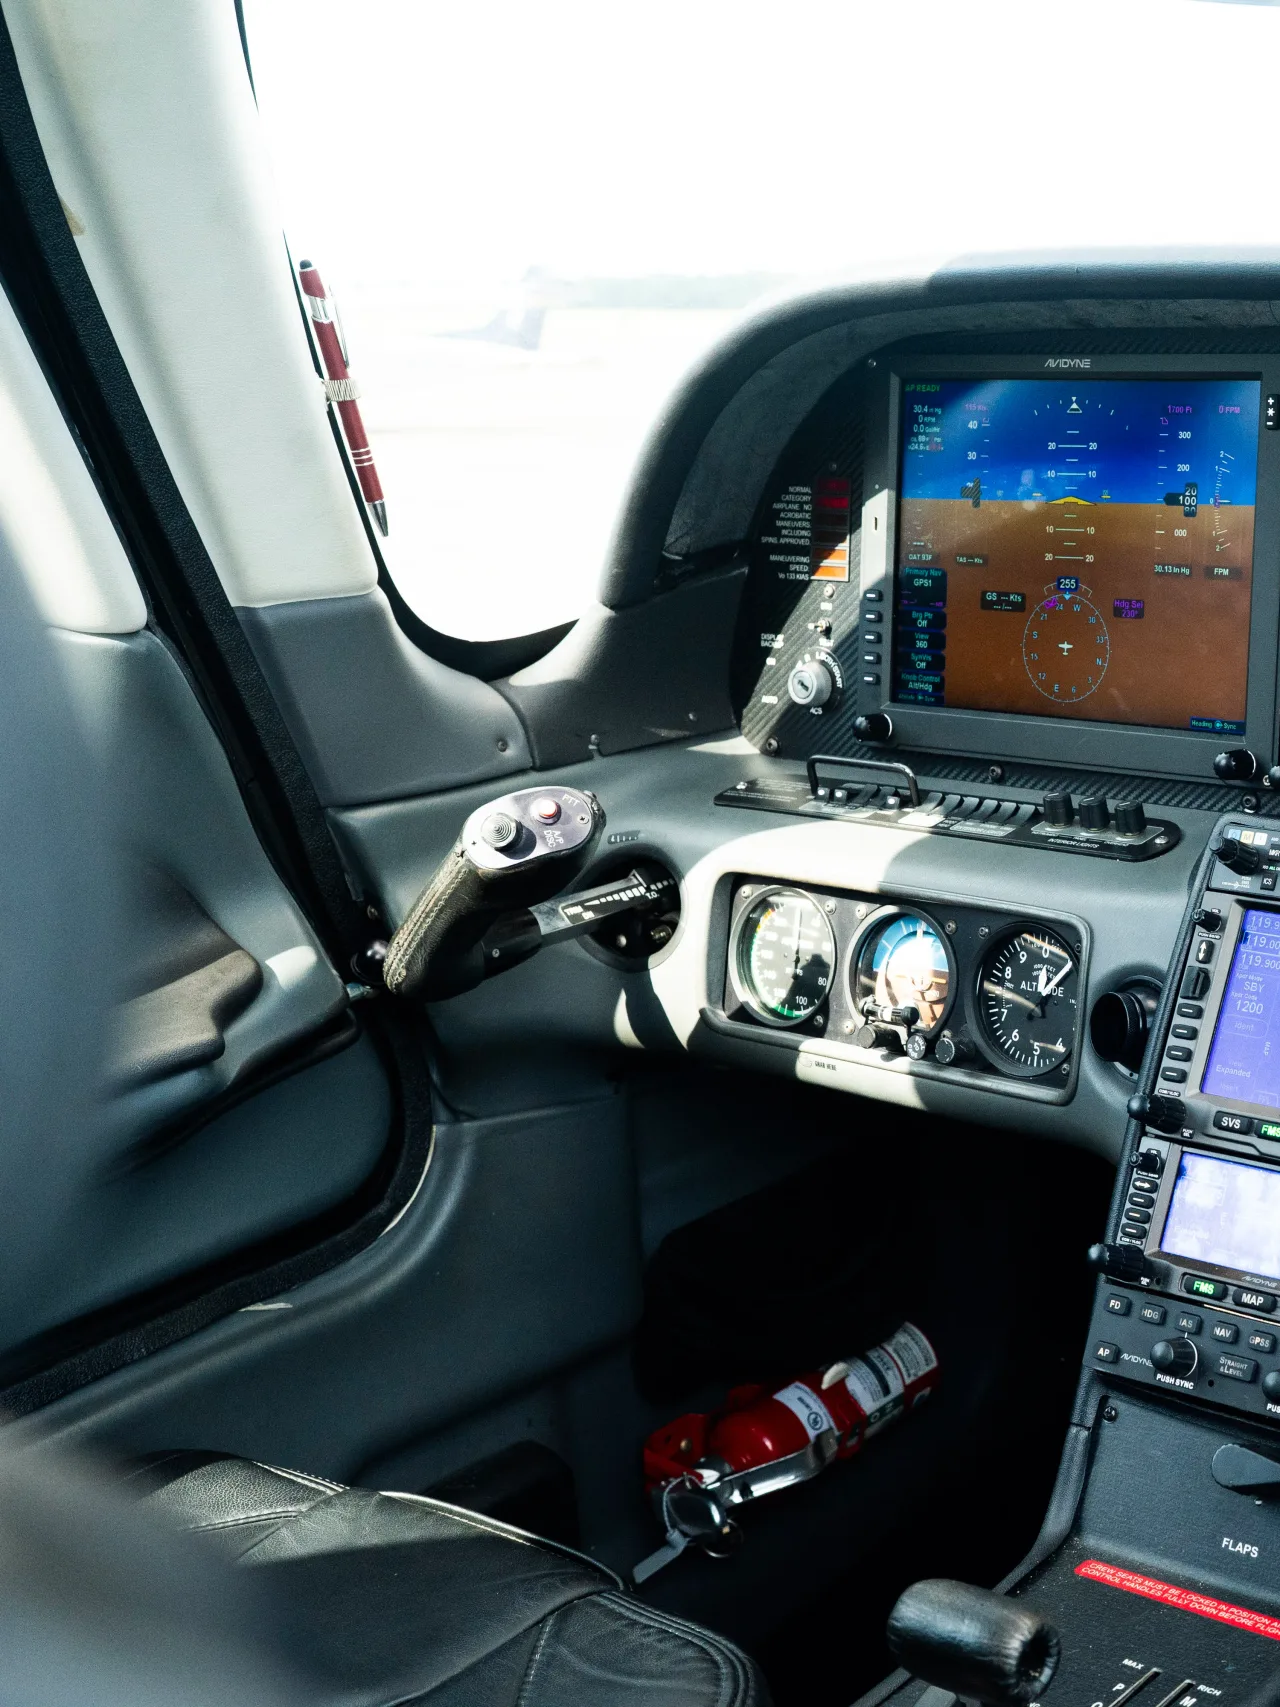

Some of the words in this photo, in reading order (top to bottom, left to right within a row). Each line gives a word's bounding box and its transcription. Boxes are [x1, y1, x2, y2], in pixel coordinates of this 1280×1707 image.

[1044, 358, 1091, 369] AVIDYNE
[1179, 497, 1197, 505] 100
[1154, 565, 1172, 573] 30.13
[1181, 567, 1190, 575] Hg
[913, 579, 932, 587] GPS1
[1059, 579, 1076, 589] 255
[986, 592, 997, 600] GS
[1010, 594, 1022, 602] Kts
[1114, 600, 1129, 609] Hdg
[561, 794, 580, 807] PTT
[1020, 951, 1027, 963] 9
[1244, 981, 1265, 993] SBY
[795, 996, 807, 1006] 100
[1236, 1000, 1264, 1015] 1200
[1012, 1029, 1019, 1041] 6
[1216, 1064, 1251, 1077] Expanded
[1221, 1117, 1241, 1129] SVS
[1193, 1280, 1215, 1294] FMS
[1241, 1293, 1264, 1306] MAP
[1141, 1308, 1159, 1320] HDG
[1213, 1326, 1231, 1338] NAV
[1156, 1374, 1174, 1385] PUSH
[1175, 1378, 1194, 1390] SYNC
[1222, 1537, 1259, 1558] FLAPS
[1081, 1567, 1121, 1584] CONTROL
[1122, 1580, 1162, 1597] HANDLES
[1163, 1593, 1189, 1605] FULLY
[1189, 1602, 1218, 1615] DOWN
[1219, 1611, 1256, 1627] BEFORE
[1090, 1563, 1113, 1574] CREW
[1115, 1571, 1143, 1584] SEATS
[1144, 1580, 1168, 1591] MUST
[1181, 1592, 1217, 1608] LOCKED
[1218, 1604, 1228, 1612] IN
[1229, 1608, 1272, 1625] POSITION
[1122, 1658, 1144, 1670] MAX
[1197, 1684, 1222, 1696] RICH
